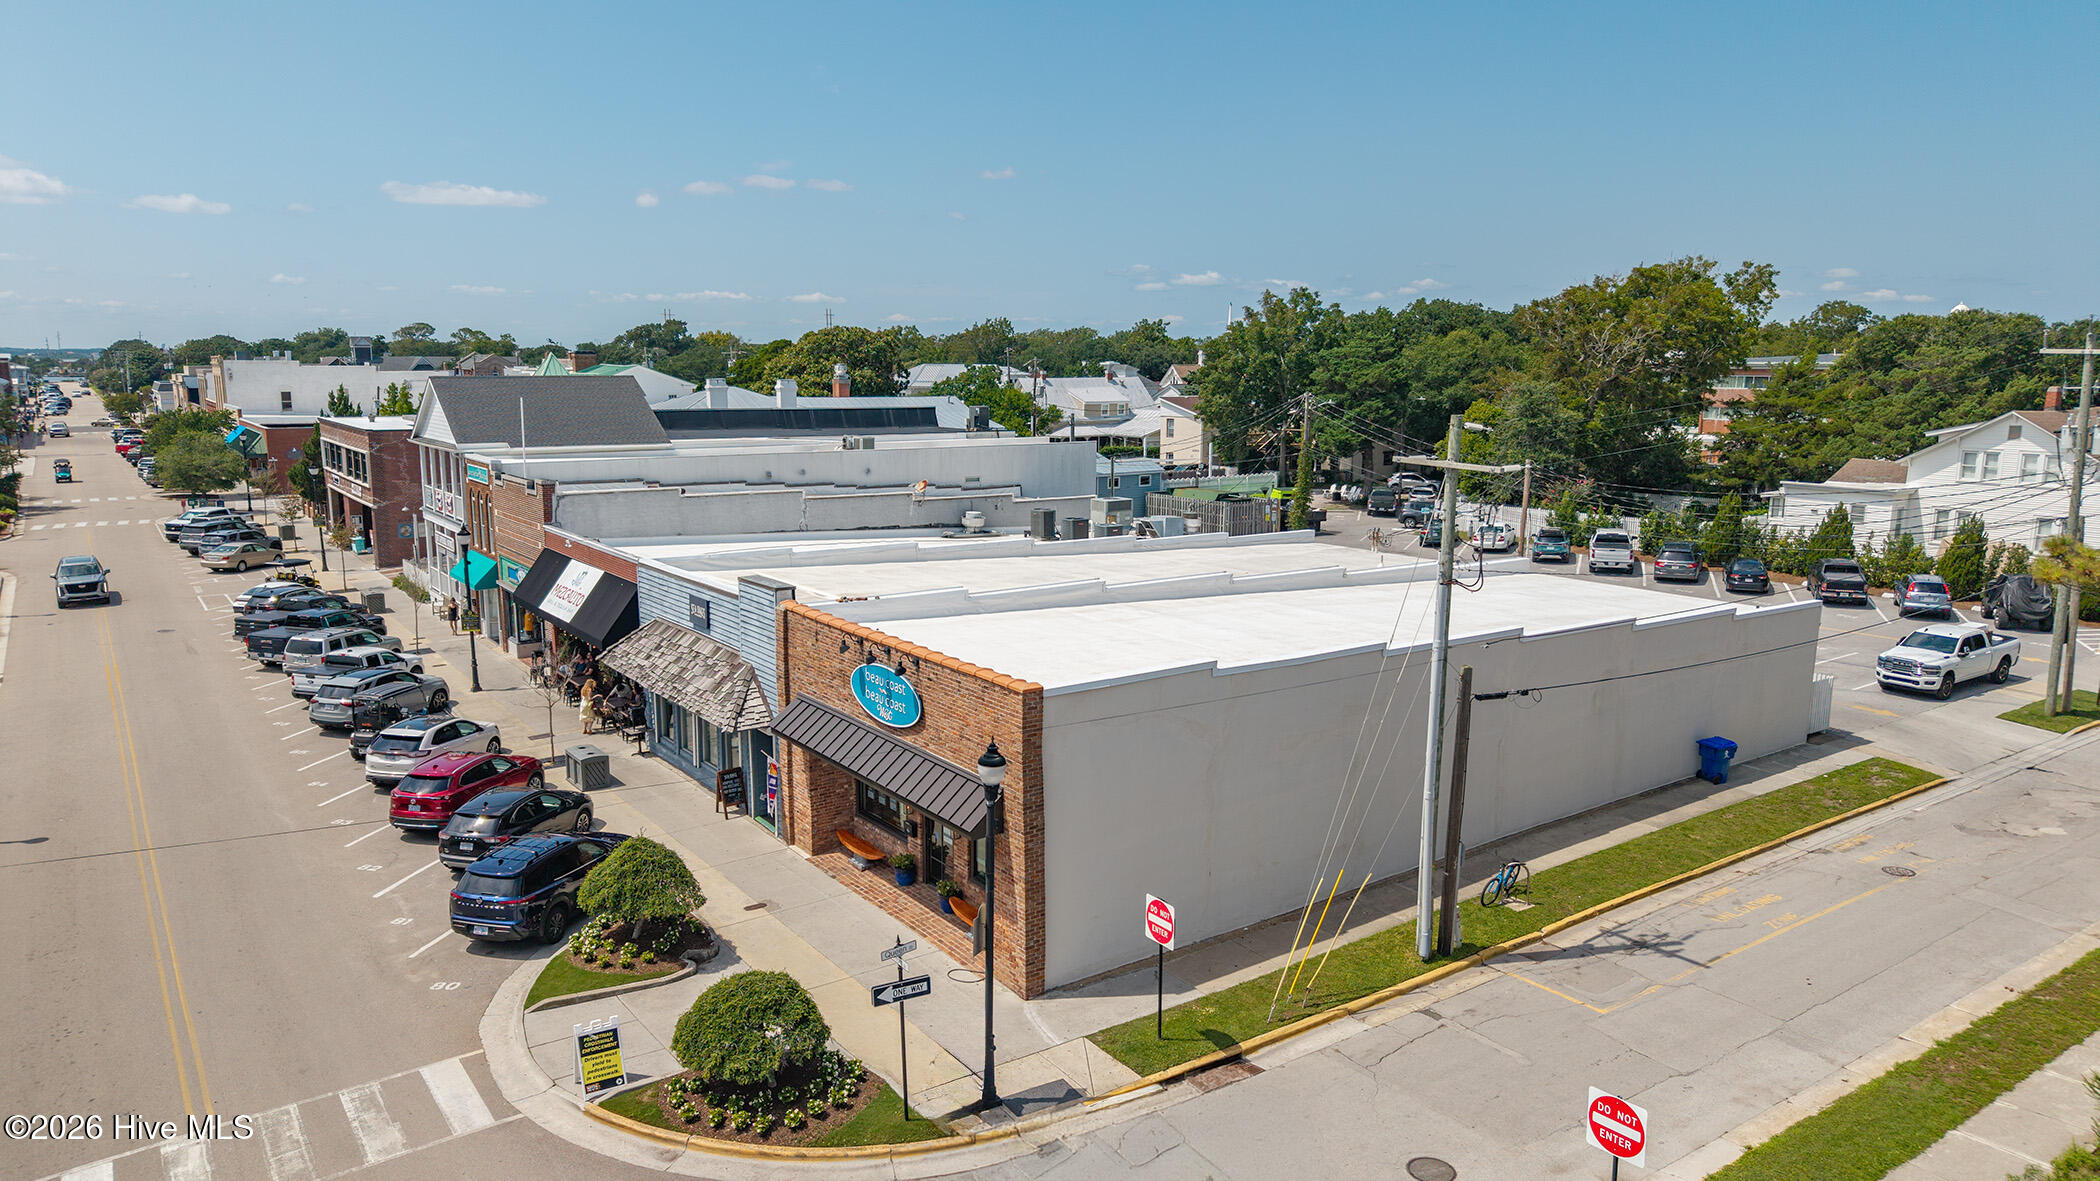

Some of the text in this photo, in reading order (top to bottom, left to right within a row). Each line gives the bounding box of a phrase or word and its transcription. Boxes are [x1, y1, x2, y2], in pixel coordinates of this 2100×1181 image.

[551, 584, 586, 607] MEZCALITO
[865, 668, 906, 696] beau coast
[865, 685, 906, 714] beau coast
[1150, 904, 1170, 920] DO NOT
[1152, 924, 1168, 938] ENTER
[884, 946, 907, 958] Queen
[429, 982, 462, 990] 80
[892, 984, 924, 997] ONE WAY
[584, 1054, 602, 1062] Drivers
[1598, 1101, 1638, 1127] DO NOT
[1600, 1128, 1632, 1151] ENTER
